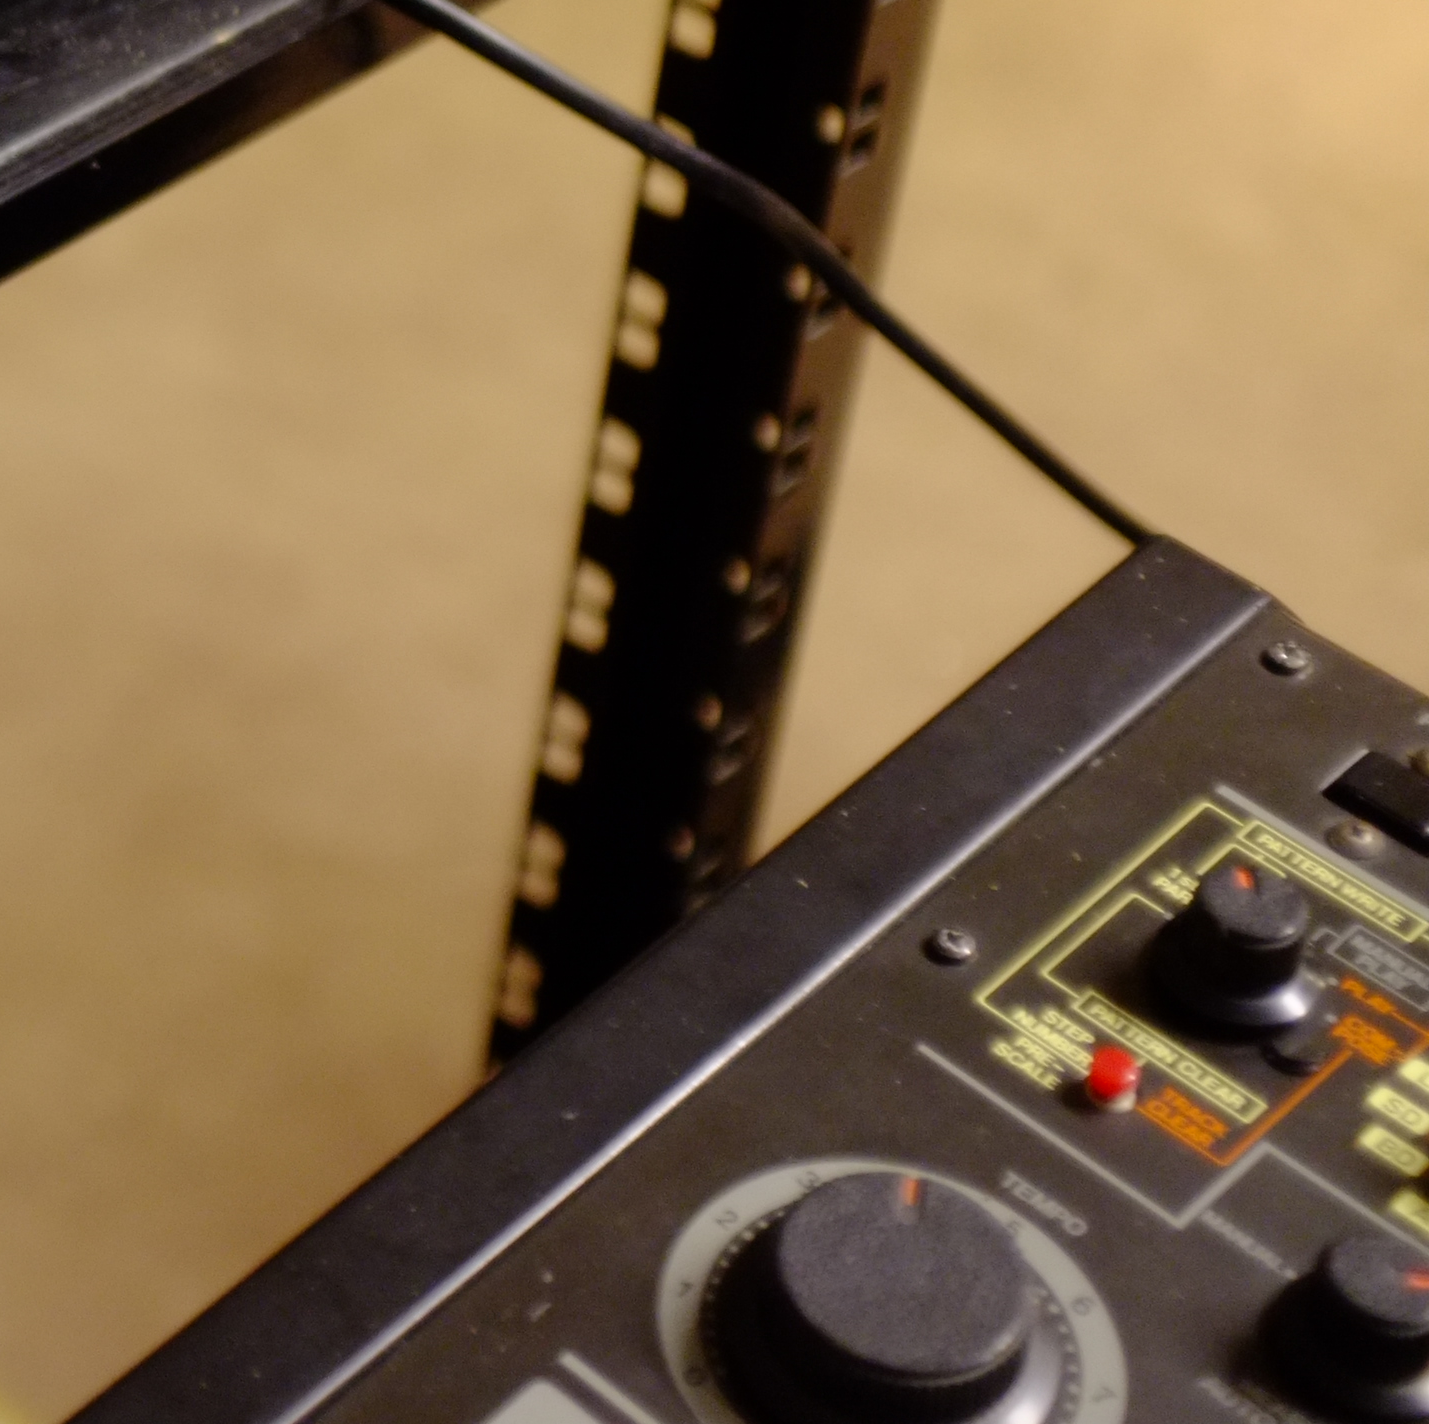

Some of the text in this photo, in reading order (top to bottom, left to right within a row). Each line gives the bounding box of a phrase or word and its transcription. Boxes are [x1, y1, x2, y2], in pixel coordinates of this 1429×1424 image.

[1151, 876, 1194, 905] PAR
[1256, 833, 1406, 927] PATTERN WRITE
[1012, 1008, 1092, 1067] NUMBER
[1042, 1008, 1095, 1044] STEP
[991, 1042, 1060, 1090] SCALE
[1088, 1003, 1248, 1110] PATTERN CLEAR
[999, 1169, 1088, 1237] TEMPO
